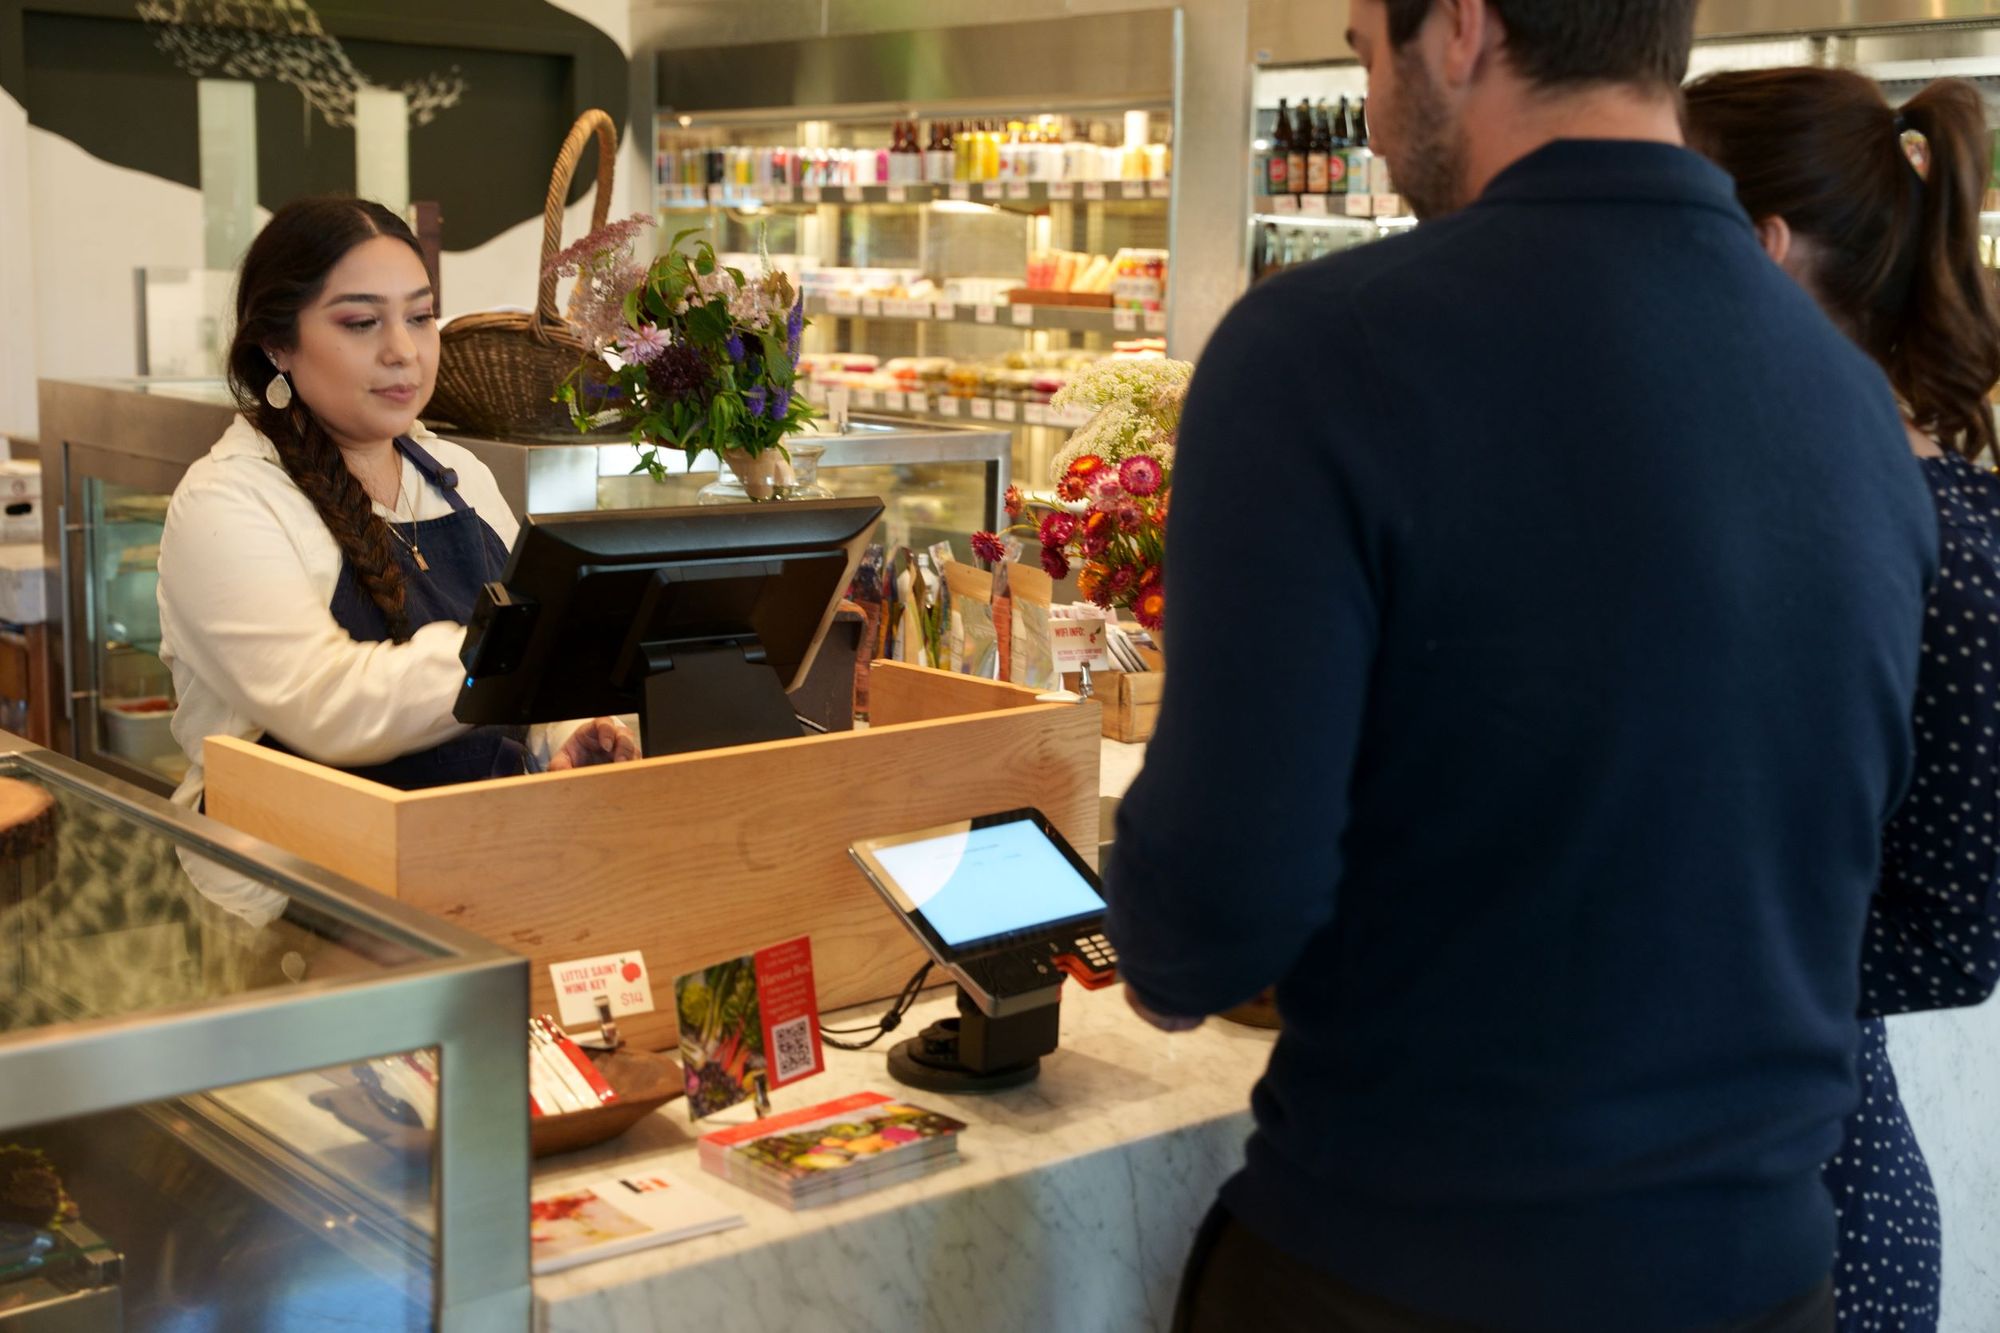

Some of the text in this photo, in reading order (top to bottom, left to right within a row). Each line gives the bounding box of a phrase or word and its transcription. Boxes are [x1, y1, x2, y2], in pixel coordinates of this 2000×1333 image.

[1055, 627, 1068, 637] WIFI
[561, 964, 617, 982] LITTLE SAINT
[564, 979, 607, 994] WINE KEY
[620, 992, 643, 1006] $14
